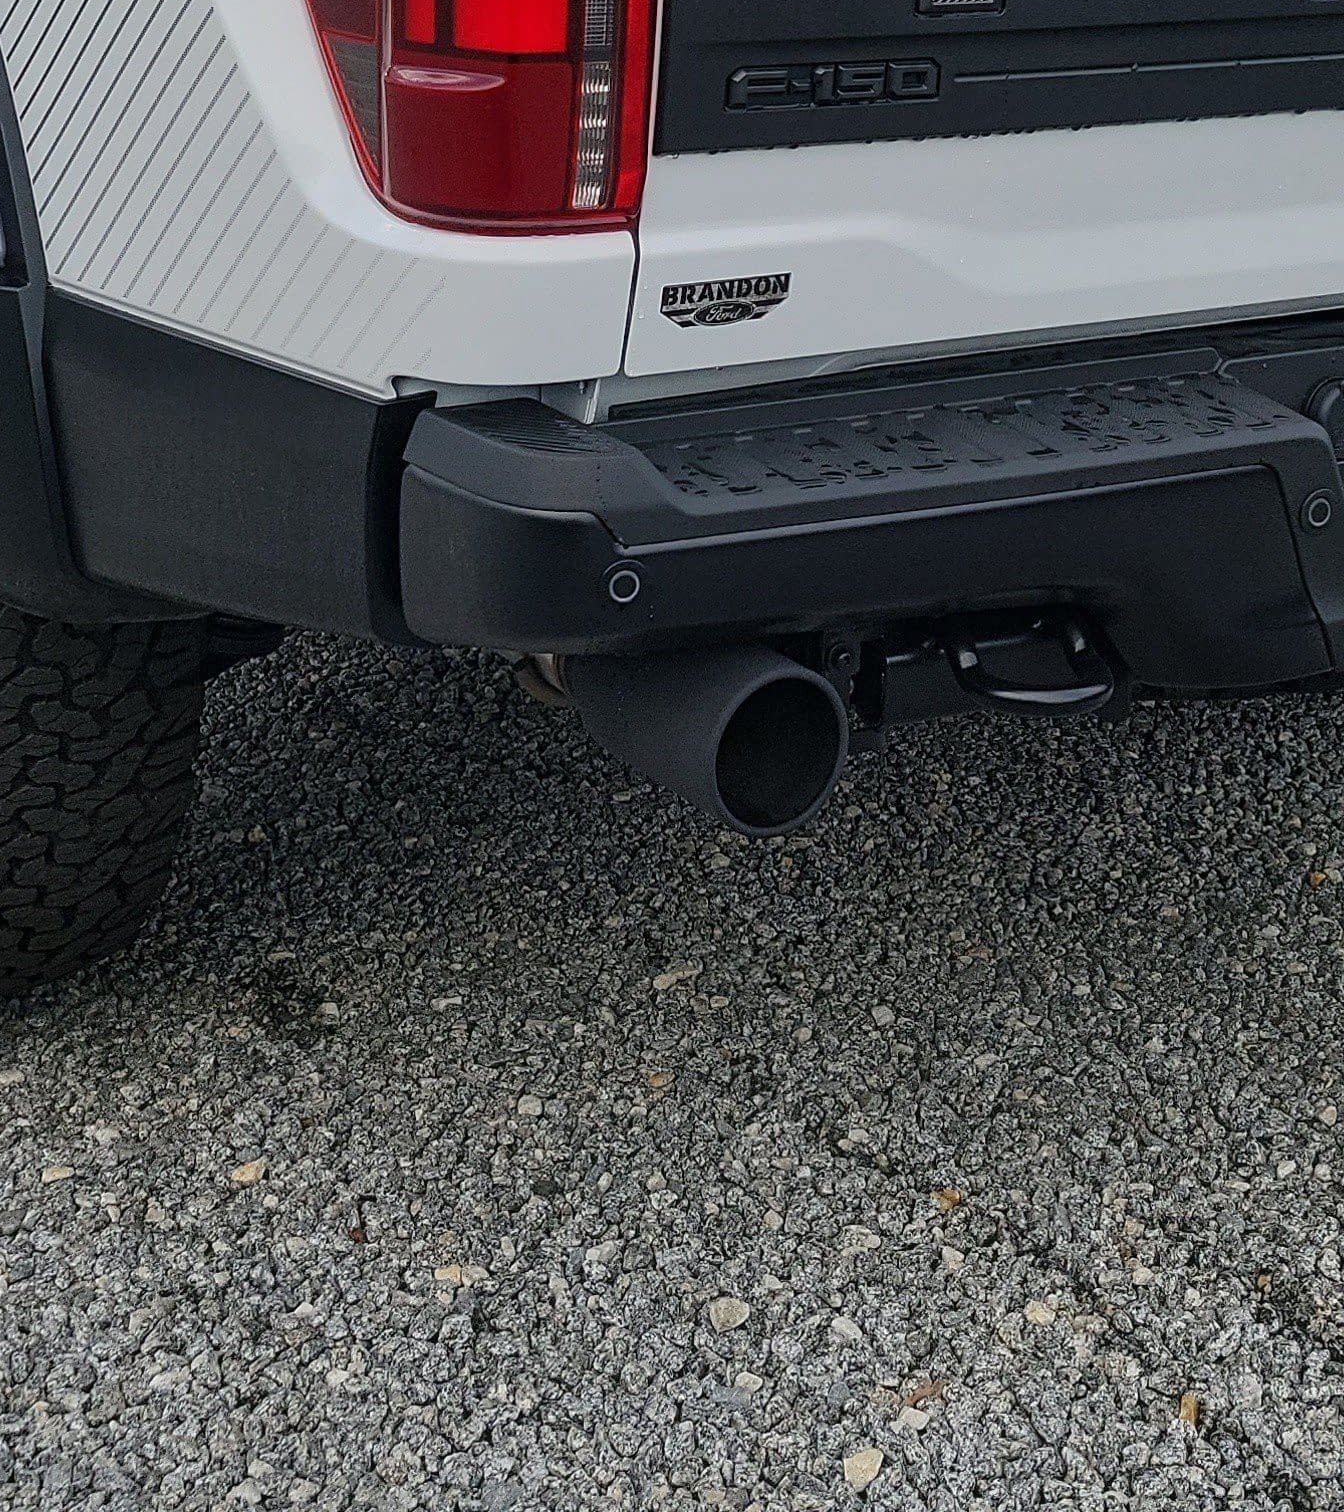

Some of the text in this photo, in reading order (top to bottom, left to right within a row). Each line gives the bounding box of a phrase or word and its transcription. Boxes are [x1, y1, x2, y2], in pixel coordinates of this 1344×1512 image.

[724, 57, 941, 112] F-150
[661, 274, 791, 307] BRANDON
[706, 305, 741, 322] Ford
